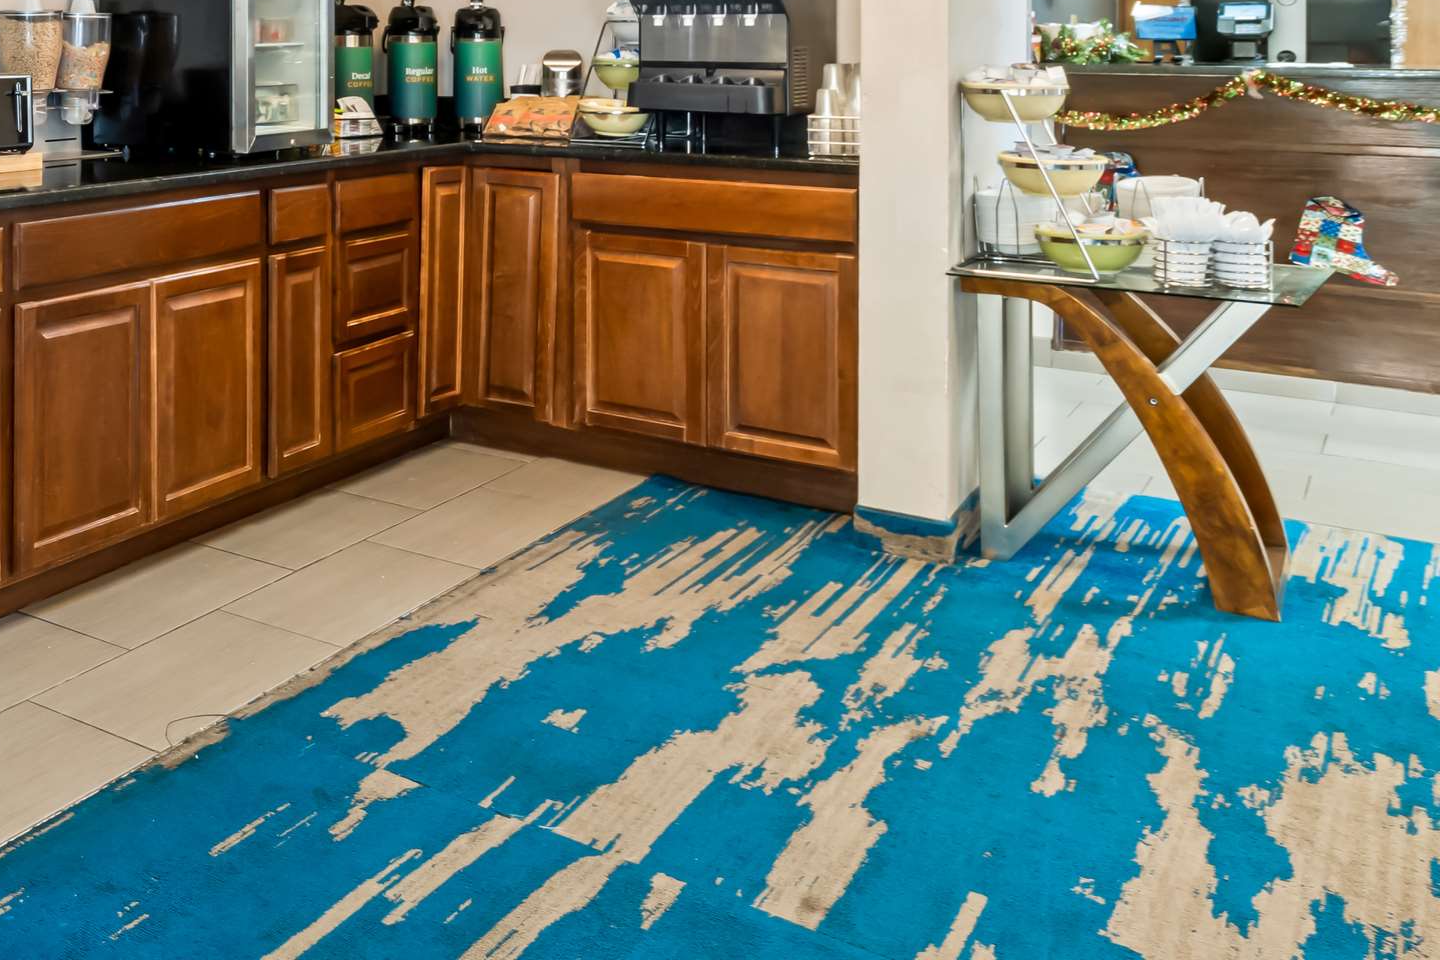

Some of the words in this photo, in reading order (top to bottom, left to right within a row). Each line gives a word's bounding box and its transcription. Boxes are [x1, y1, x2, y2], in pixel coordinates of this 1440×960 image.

[405, 67, 434, 77] Regular
[472, 66, 488, 74] Hot
[465, 75, 495, 83] WATER
